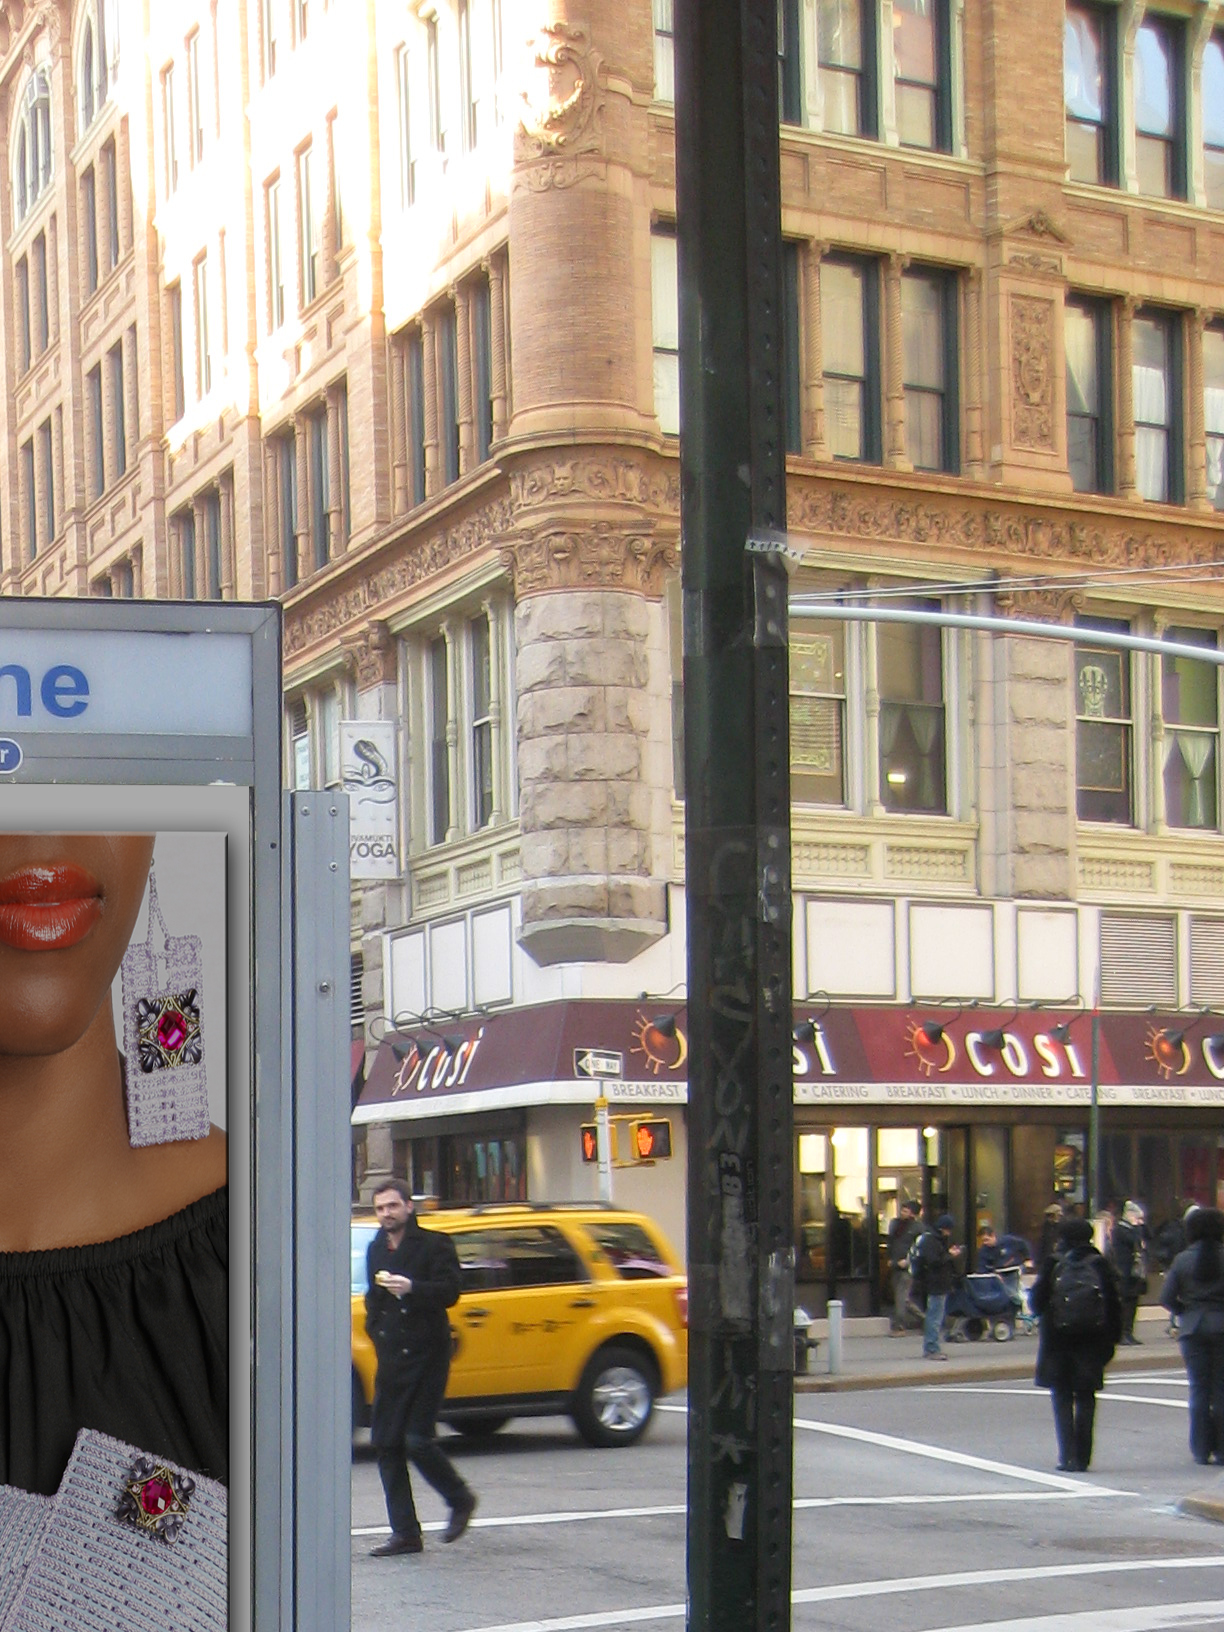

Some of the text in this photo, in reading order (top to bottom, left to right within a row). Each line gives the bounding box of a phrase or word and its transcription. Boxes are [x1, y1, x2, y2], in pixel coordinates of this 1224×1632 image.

[584, 1059, 618, 1071] ONE WAY
[611, 1083, 680, 1097] BREAKFAST
[811, 1085, 870, 1098] CATERING
[885, 1086, 1117, 1100] BREAKFAST LUNCH DINNER CATENG
[1131, 1087, 1186, 1100] BREAKFAST
